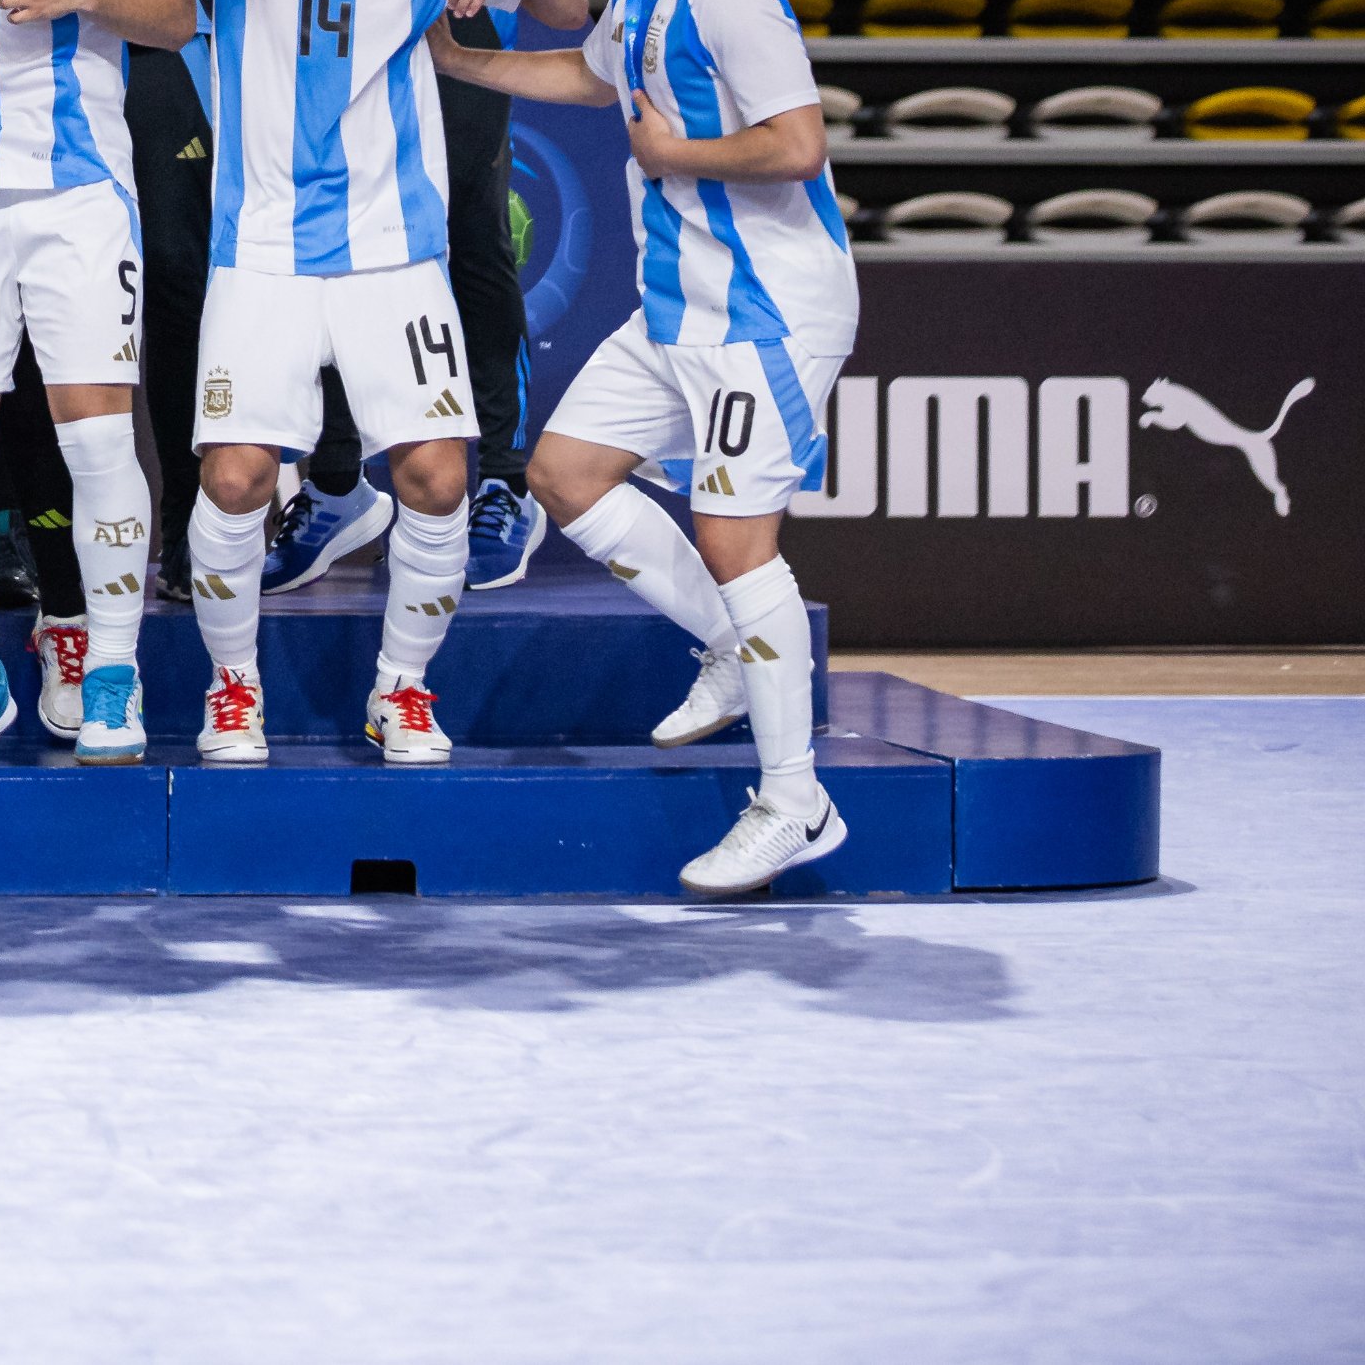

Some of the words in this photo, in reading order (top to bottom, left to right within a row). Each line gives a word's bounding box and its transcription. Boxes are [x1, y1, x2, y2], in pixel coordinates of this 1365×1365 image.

[117, 259, 139, 326] 5
[404, 313, 459, 387] 14
[704, 385, 757, 459] 10
[93, 516, 146, 549] AFA
